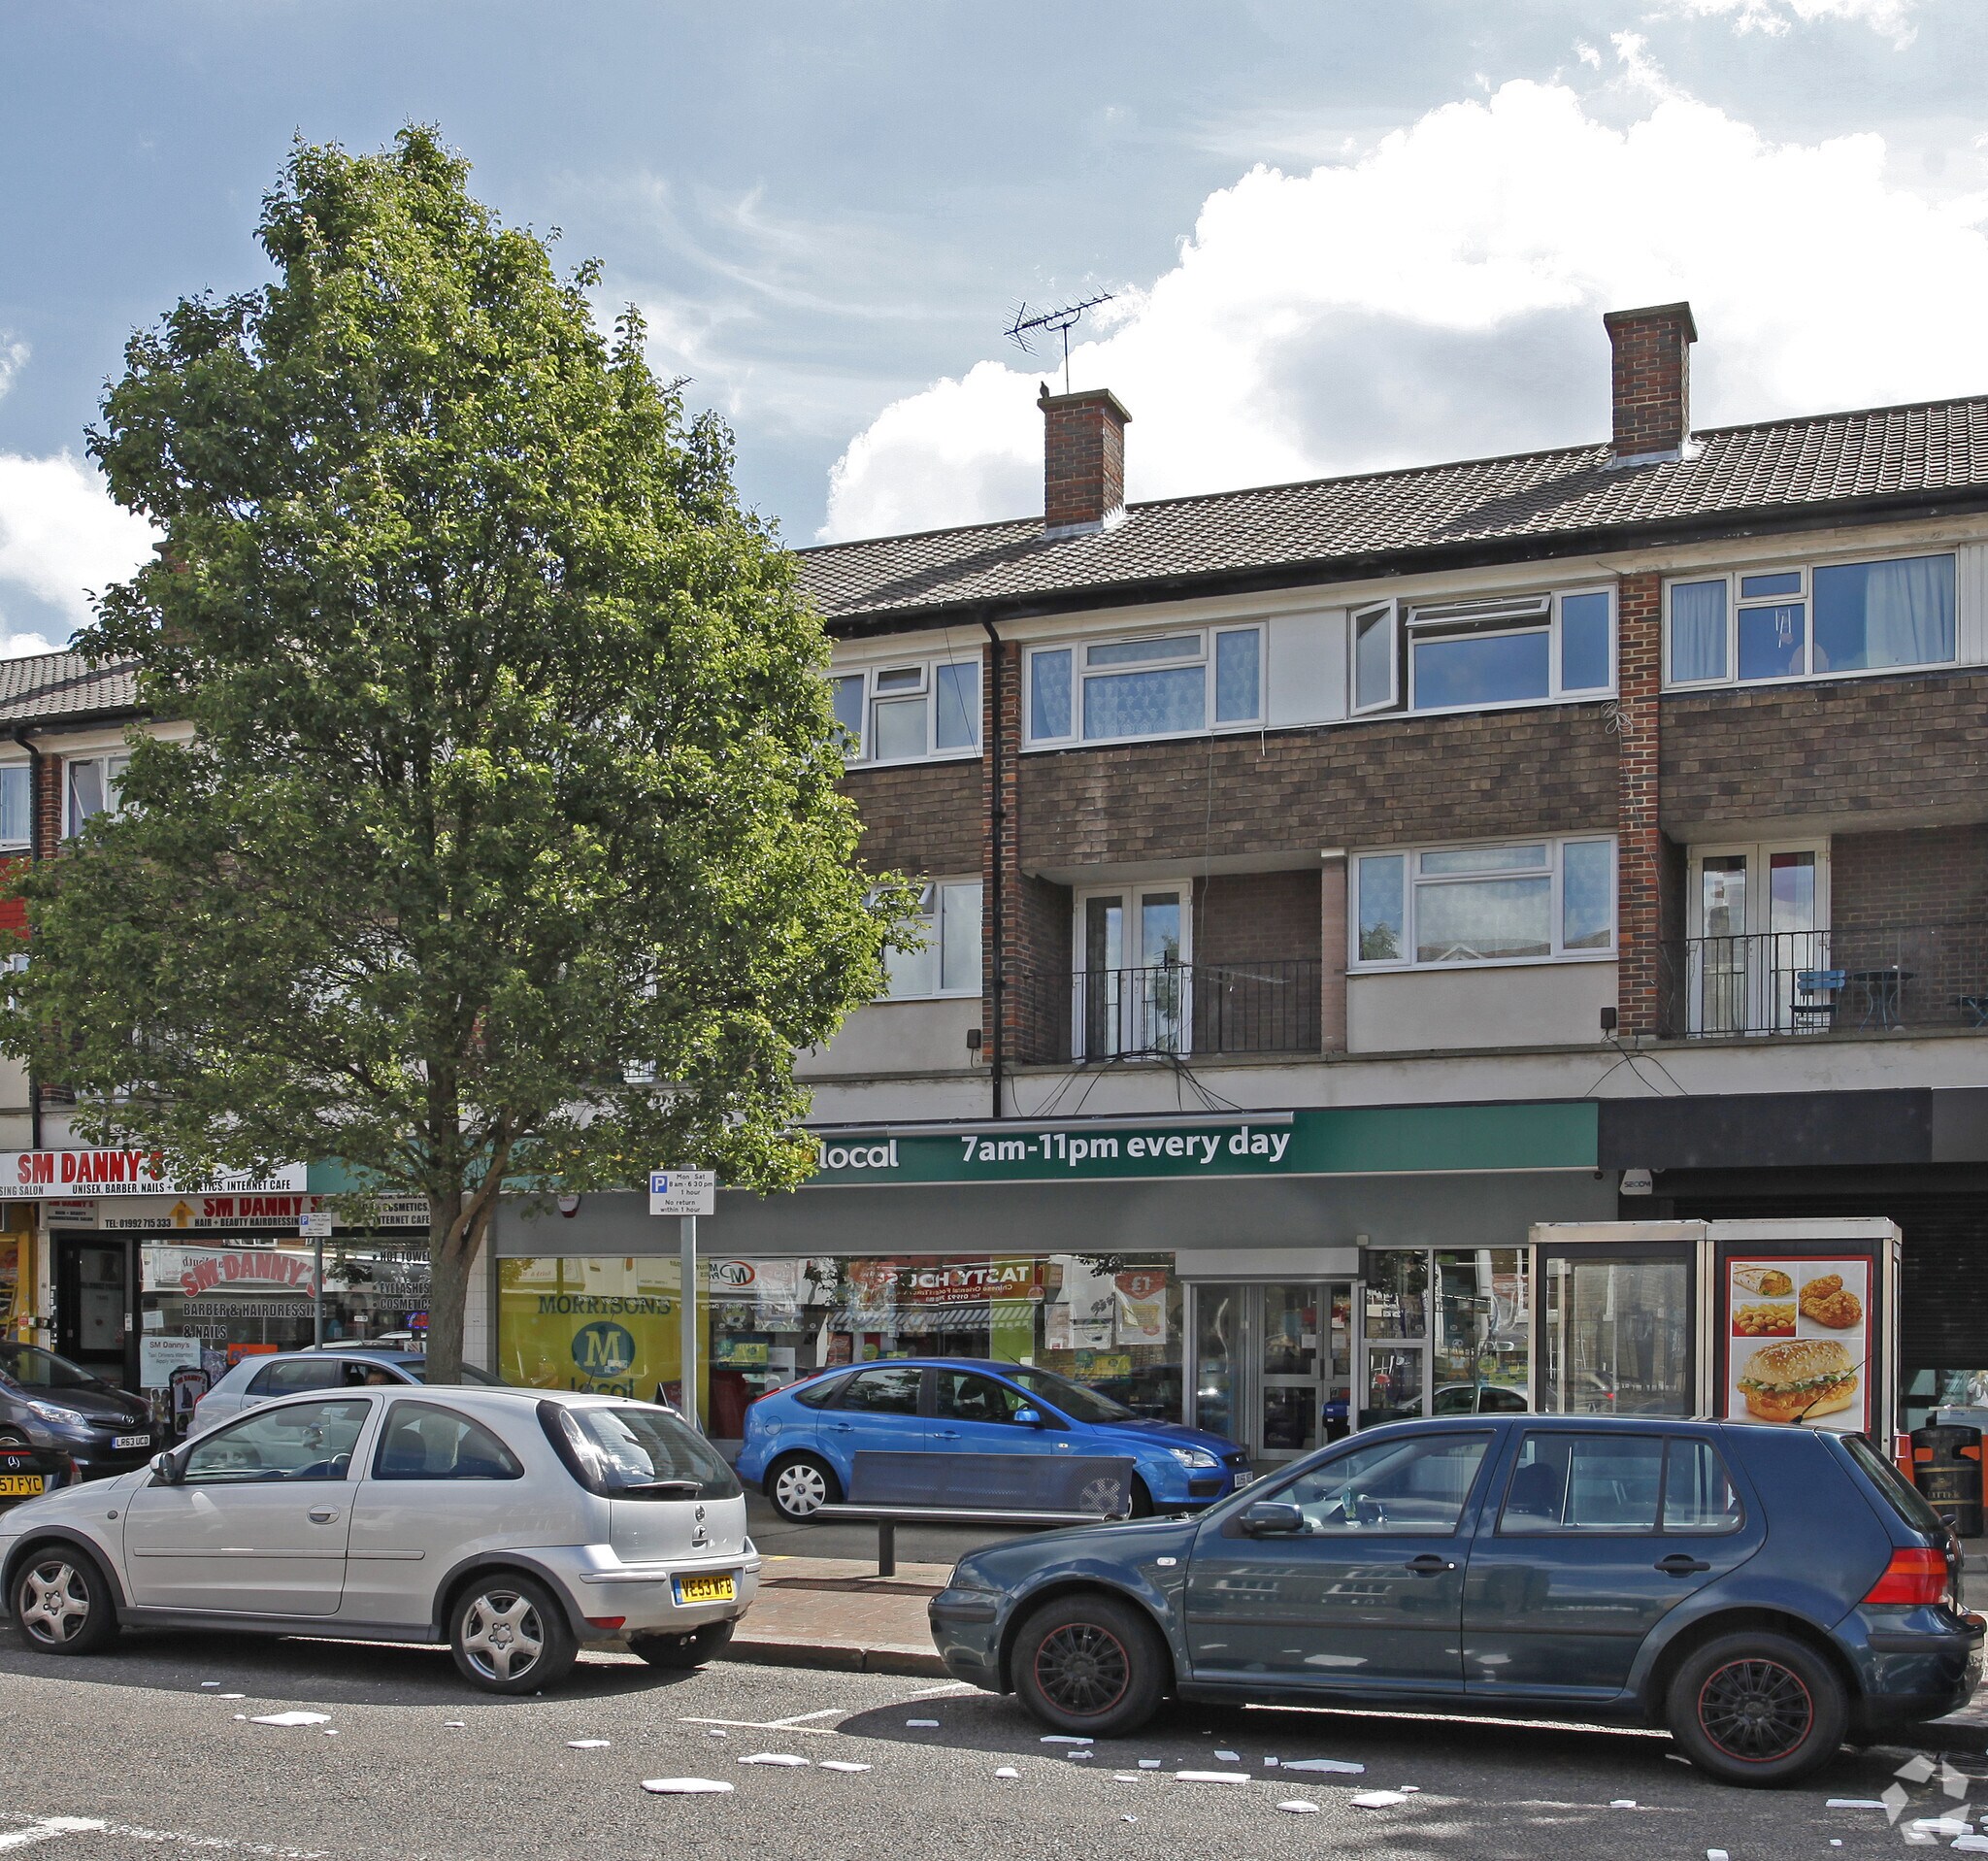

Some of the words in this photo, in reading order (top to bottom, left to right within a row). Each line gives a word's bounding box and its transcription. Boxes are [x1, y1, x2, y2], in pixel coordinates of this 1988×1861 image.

[961, 1133, 1118, 1166] 7am-11pm
[1127, 1132, 1221, 1164] every
[1228, 1126, 1291, 1162] day
[819, 1139, 899, 1169] local
[17, 1152, 54, 1184] SM
[18, 1185, 44, 1196] SALON
[141, 1182, 165, 1193] NAILS
[227, 1180, 268, 1191] INTERNET
[269, 1180, 291, 1190] CAFE
[204, 1197, 234, 1217] SM
[104, 1218, 118, 1229] TEL:
[119, 1218, 142, 1229] 01992
[144, 1218, 156, 1228] 715
[157, 1218, 172, 1228] 333
[194, 1216, 213, 1227] HAIR
[219, 1216, 248, 1227] BEAUTY
[248, 1215, 300, 1227] HAIRDRESSIN
[414, 1215, 430, 1224] CAFE
[180, 1259, 221, 1298] SM
[1130, 1275, 1151, 1291] £1
[380, 1281, 430, 1294] EYELASHES
[183, 1303, 228, 1317] BARBER
[229, 1303, 242, 1317] &
[538, 1295, 672, 1314] MORRISONS
[182, 1325, 192, 1339] &
[194, 1324, 227, 1339] NAILS
[163, 1341, 190, 1349] Danny's
[584, 1331, 621, 1367] M
[116, 1438, 135, 1446] LR63
[136, 1436, 149, 1446] UCD
[17, 1475, 42, 1492] FYC
[682, 1579, 712, 1598] VE53
